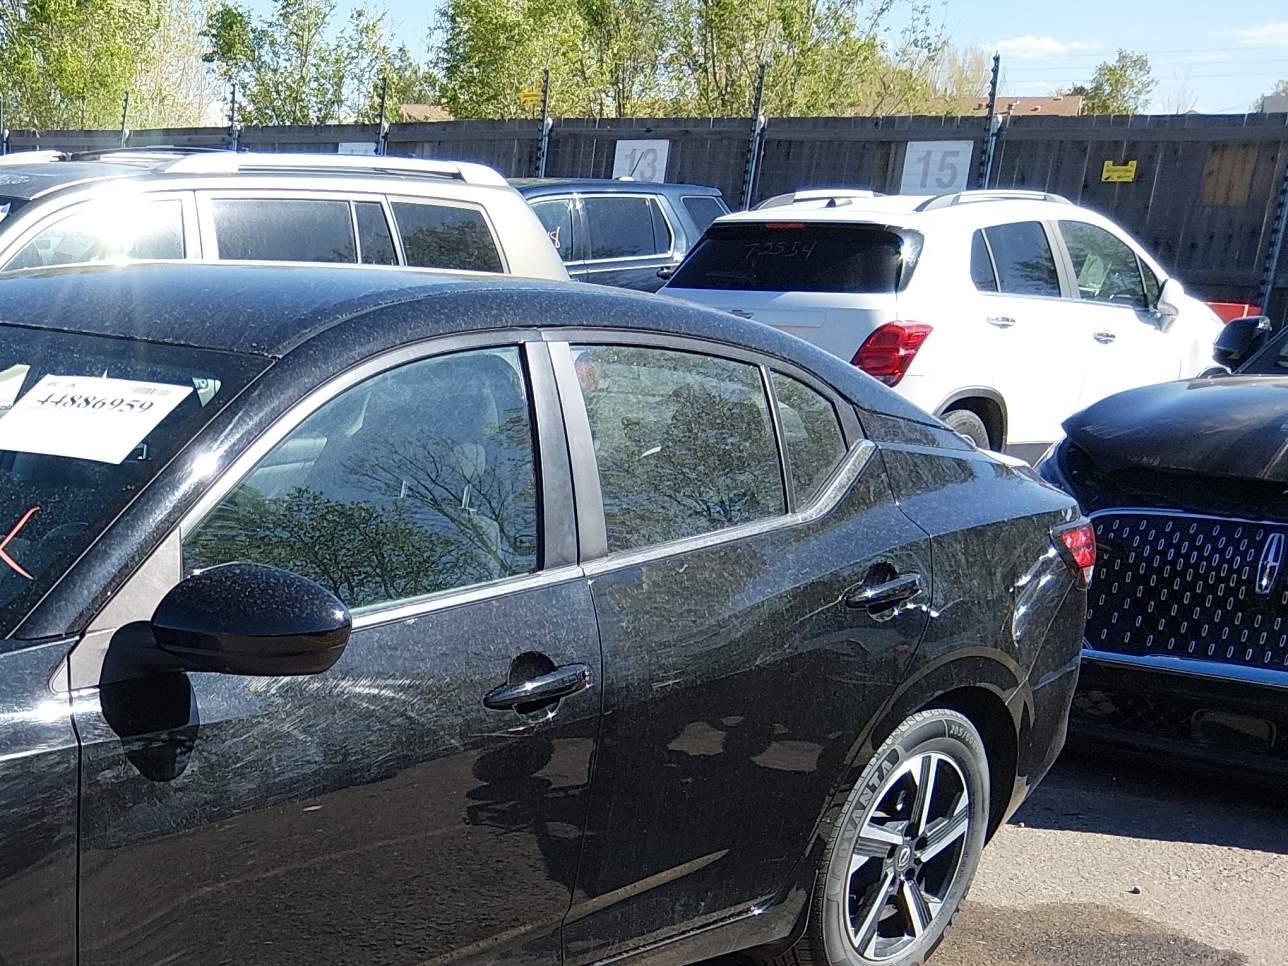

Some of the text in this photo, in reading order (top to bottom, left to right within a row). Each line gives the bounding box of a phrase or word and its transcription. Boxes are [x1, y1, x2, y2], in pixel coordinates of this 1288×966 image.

[624, 148, 658, 181] 13
[916, 149, 961, 190] 15
[37, 392, 156, 413] 44886959
